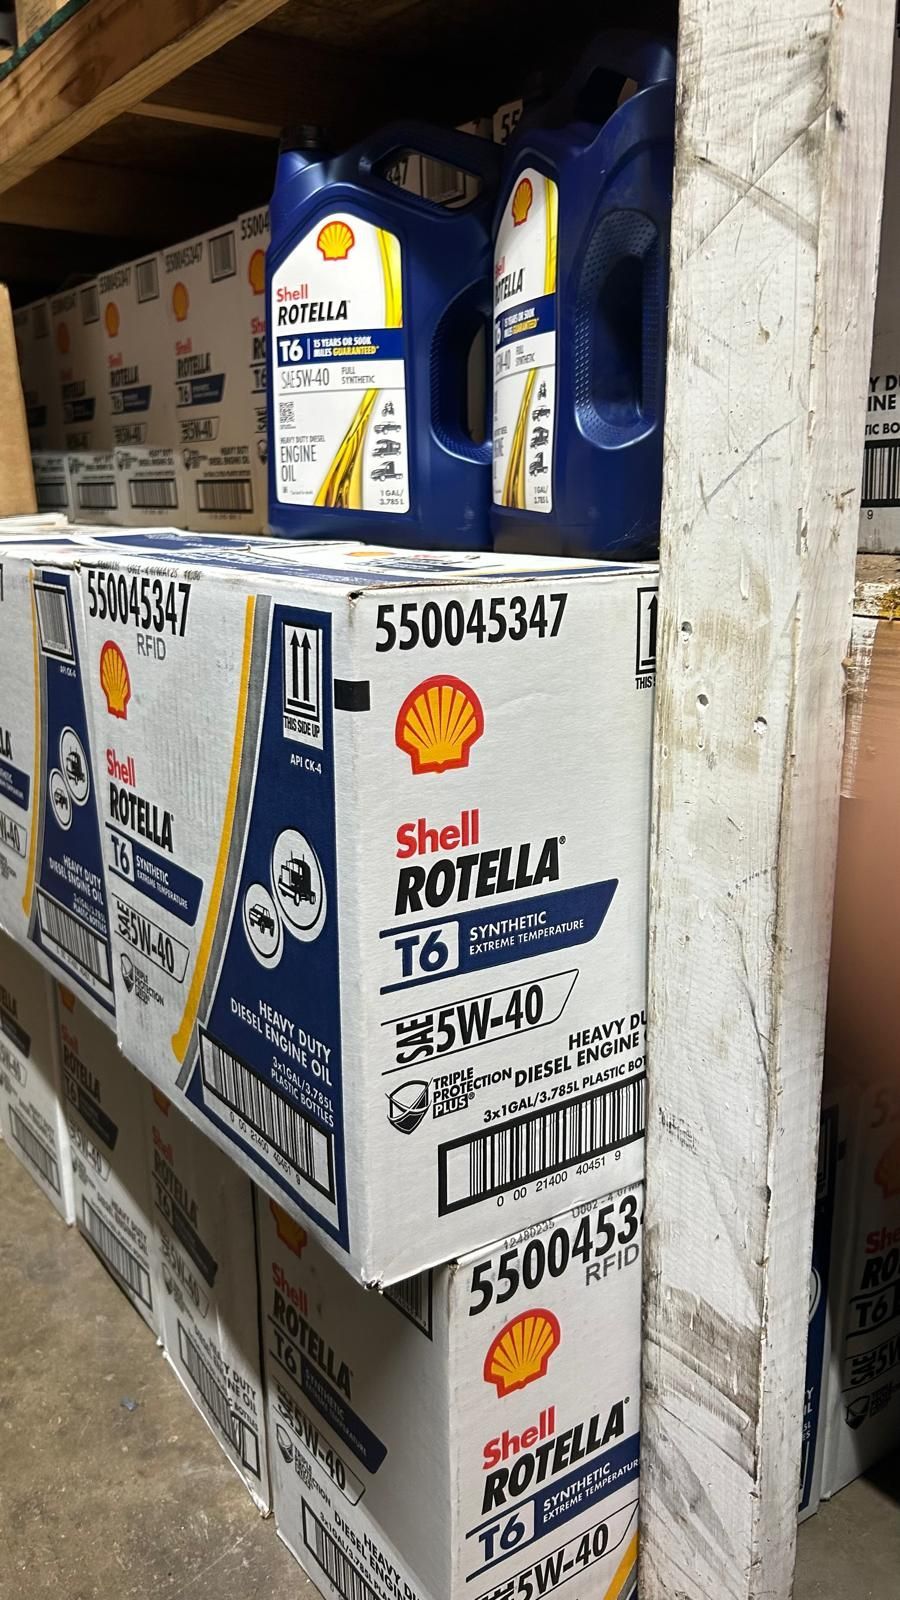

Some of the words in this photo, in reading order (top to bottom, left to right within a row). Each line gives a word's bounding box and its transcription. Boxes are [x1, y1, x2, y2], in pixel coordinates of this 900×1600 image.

[240, 210, 270, 241] 55004
[276, 283, 308, 303] Shell
[277, 300, 350, 326] ROTELLA
[279, 339, 304, 362] T6
[341, 366, 356, 375] FULL
[341, 375, 375, 385] SYNTHETIC
[867, 394, 896, 412] INE
[280, 444, 317, 463] ENGINE
[281, 465, 297, 482] OIL
[88, 570, 191, 638] 550045347
[375, 592, 568, 653] 550045347
[136, 632, 166, 661] RFID
[635, 676, 652, 691] THIS
[284, 716, 297, 731] THIS
[297, 719, 312, 735] SIDE
[311, 723, 320, 738] UP
[106, 748, 136, 788] Shell
[290, 753, 303, 768] API
[304, 758, 322, 775] CK-4
[395, 808, 480, 859] Shell
[63, 853, 84, 876] HEAVY
[84, 869, 102, 889] DUTY
[110, 834, 130, 877] T6
[136, 854, 169, 886] SYNTHETIC
[49, 857, 68, 880] DIESEL
[68, 871, 91, 897] ENGINE
[92, 886, 104, 906] OIL
[155, 880, 188, 910] TEMPERATURE
[117, 900, 131, 941] SAE
[131, 910, 174, 974] 5W-40
[469, 910, 547, 942] SYNTHETIC
[469, 935, 515, 956] EXTREME
[518, 918, 585, 944] TEMPERATURE
[395, 929, 449, 978] T6
[230, 997, 263, 1035] DIESEL
[265, 1023, 308, 1068] ENGINE
[311, 1059, 333, 1087] OIL
[258, 1000, 294, 1038] HEAVY
[299, 1028, 332, 1064] DUTY
[395, 1013, 434, 1064] SAE
[436, 984, 544, 1053] 5W-40
[568, 1017, 626, 1051] HEAVY
[630, 1010, 646, 1031] DU
[433, 1067, 475, 1089] TRIPLE
[514, 1054, 572, 1088] DIESEL
[577, 1031, 640, 1067] ENGINE
[271, 1069, 299, 1100] PLASTIC
[300, 1092, 335, 1128] BOTTLES
[433, 1067, 513, 1103] PROTECTION
[483, 1081, 580, 1123] 3x1GAL/3.785L
[582, 1065, 626, 1089] PLASTIC
[496, 1195, 505, 1207] 0
[513, 1187, 527, 1201] 00
[535, 1171, 568, 1193] 21400
[575, 1158, 606, 1176] 40451
[614, 1150, 621, 1161] 9
[469, 1194, 644, 1317] 5500453
[585, 1243, 640, 1286] RFID
[272, 1262, 309, 1318] Shell
[856, 1294, 887, 1327] T6
[274, 1329, 298, 1375] T6
[233, 1370, 256, 1400] DUTY
[243, 1392, 257, 1416] OIL
[294, 1408, 346, 1491] 5W-40
[482, 1405, 555, 1470] Shell
[543, 1462, 611, 1512] SYNTHETIC
[543, 1494, 583, 1523] EXTREME
[585, 1459, 640, 1496] TEMPERATUR
[334, 1510, 367, 1560] DIESEL
[478, 1512, 526, 1562] T6
[363, 1532, 401, 1585] HEAVY
[517, 1523, 609, 1600] 5W-40
